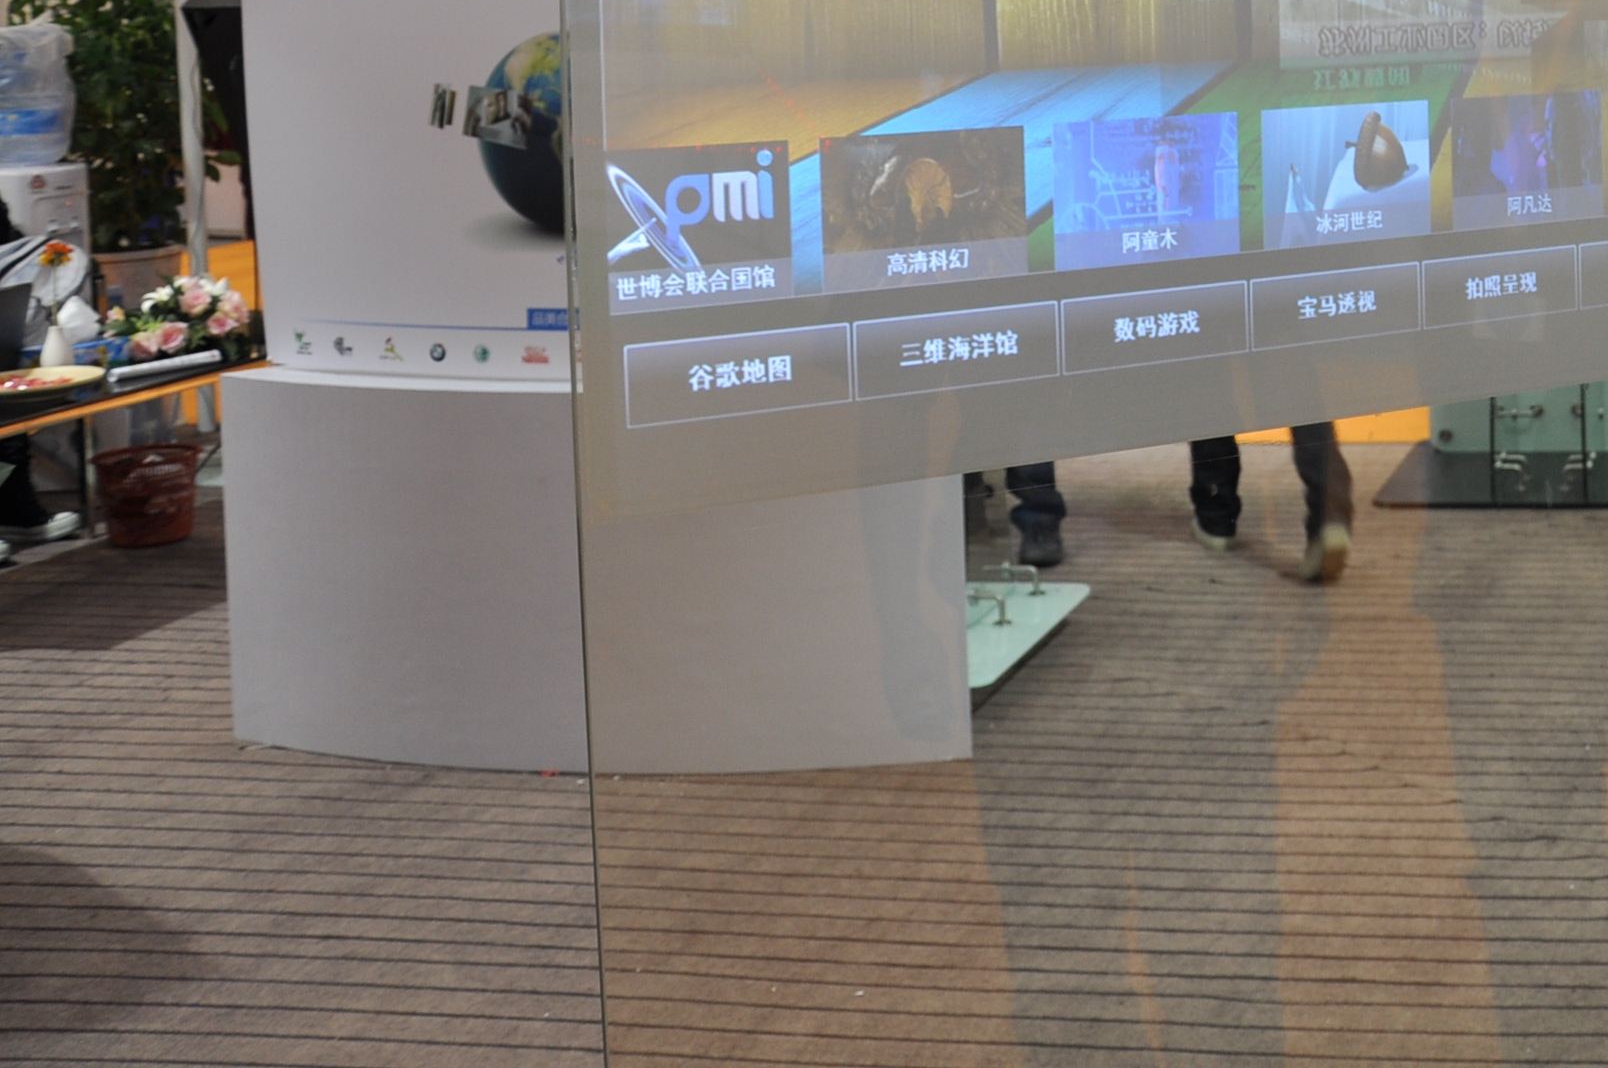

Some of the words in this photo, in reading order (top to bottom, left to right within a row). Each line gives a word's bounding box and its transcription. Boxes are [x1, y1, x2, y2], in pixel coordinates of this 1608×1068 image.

[664, 149, 775, 244] pmi
[1506, 195, 1553, 216] 阿凡达
[1315, 210, 1384, 235] 冰河世纪
[1121, 228, 1178, 254] 阿童木
[886, 248, 971, 276] 高清科幻
[616, 265, 777, 301] 世博会联合国馆
[1465, 271, 1538, 301] 拍照呈现
[1297, 290, 1378, 320] 宝马透视
[1113, 310, 1201, 343] 数码游戏
[899, 330, 1020, 368] 三维海洋馆
[688, 355, 793, 392] 谷歌地图
